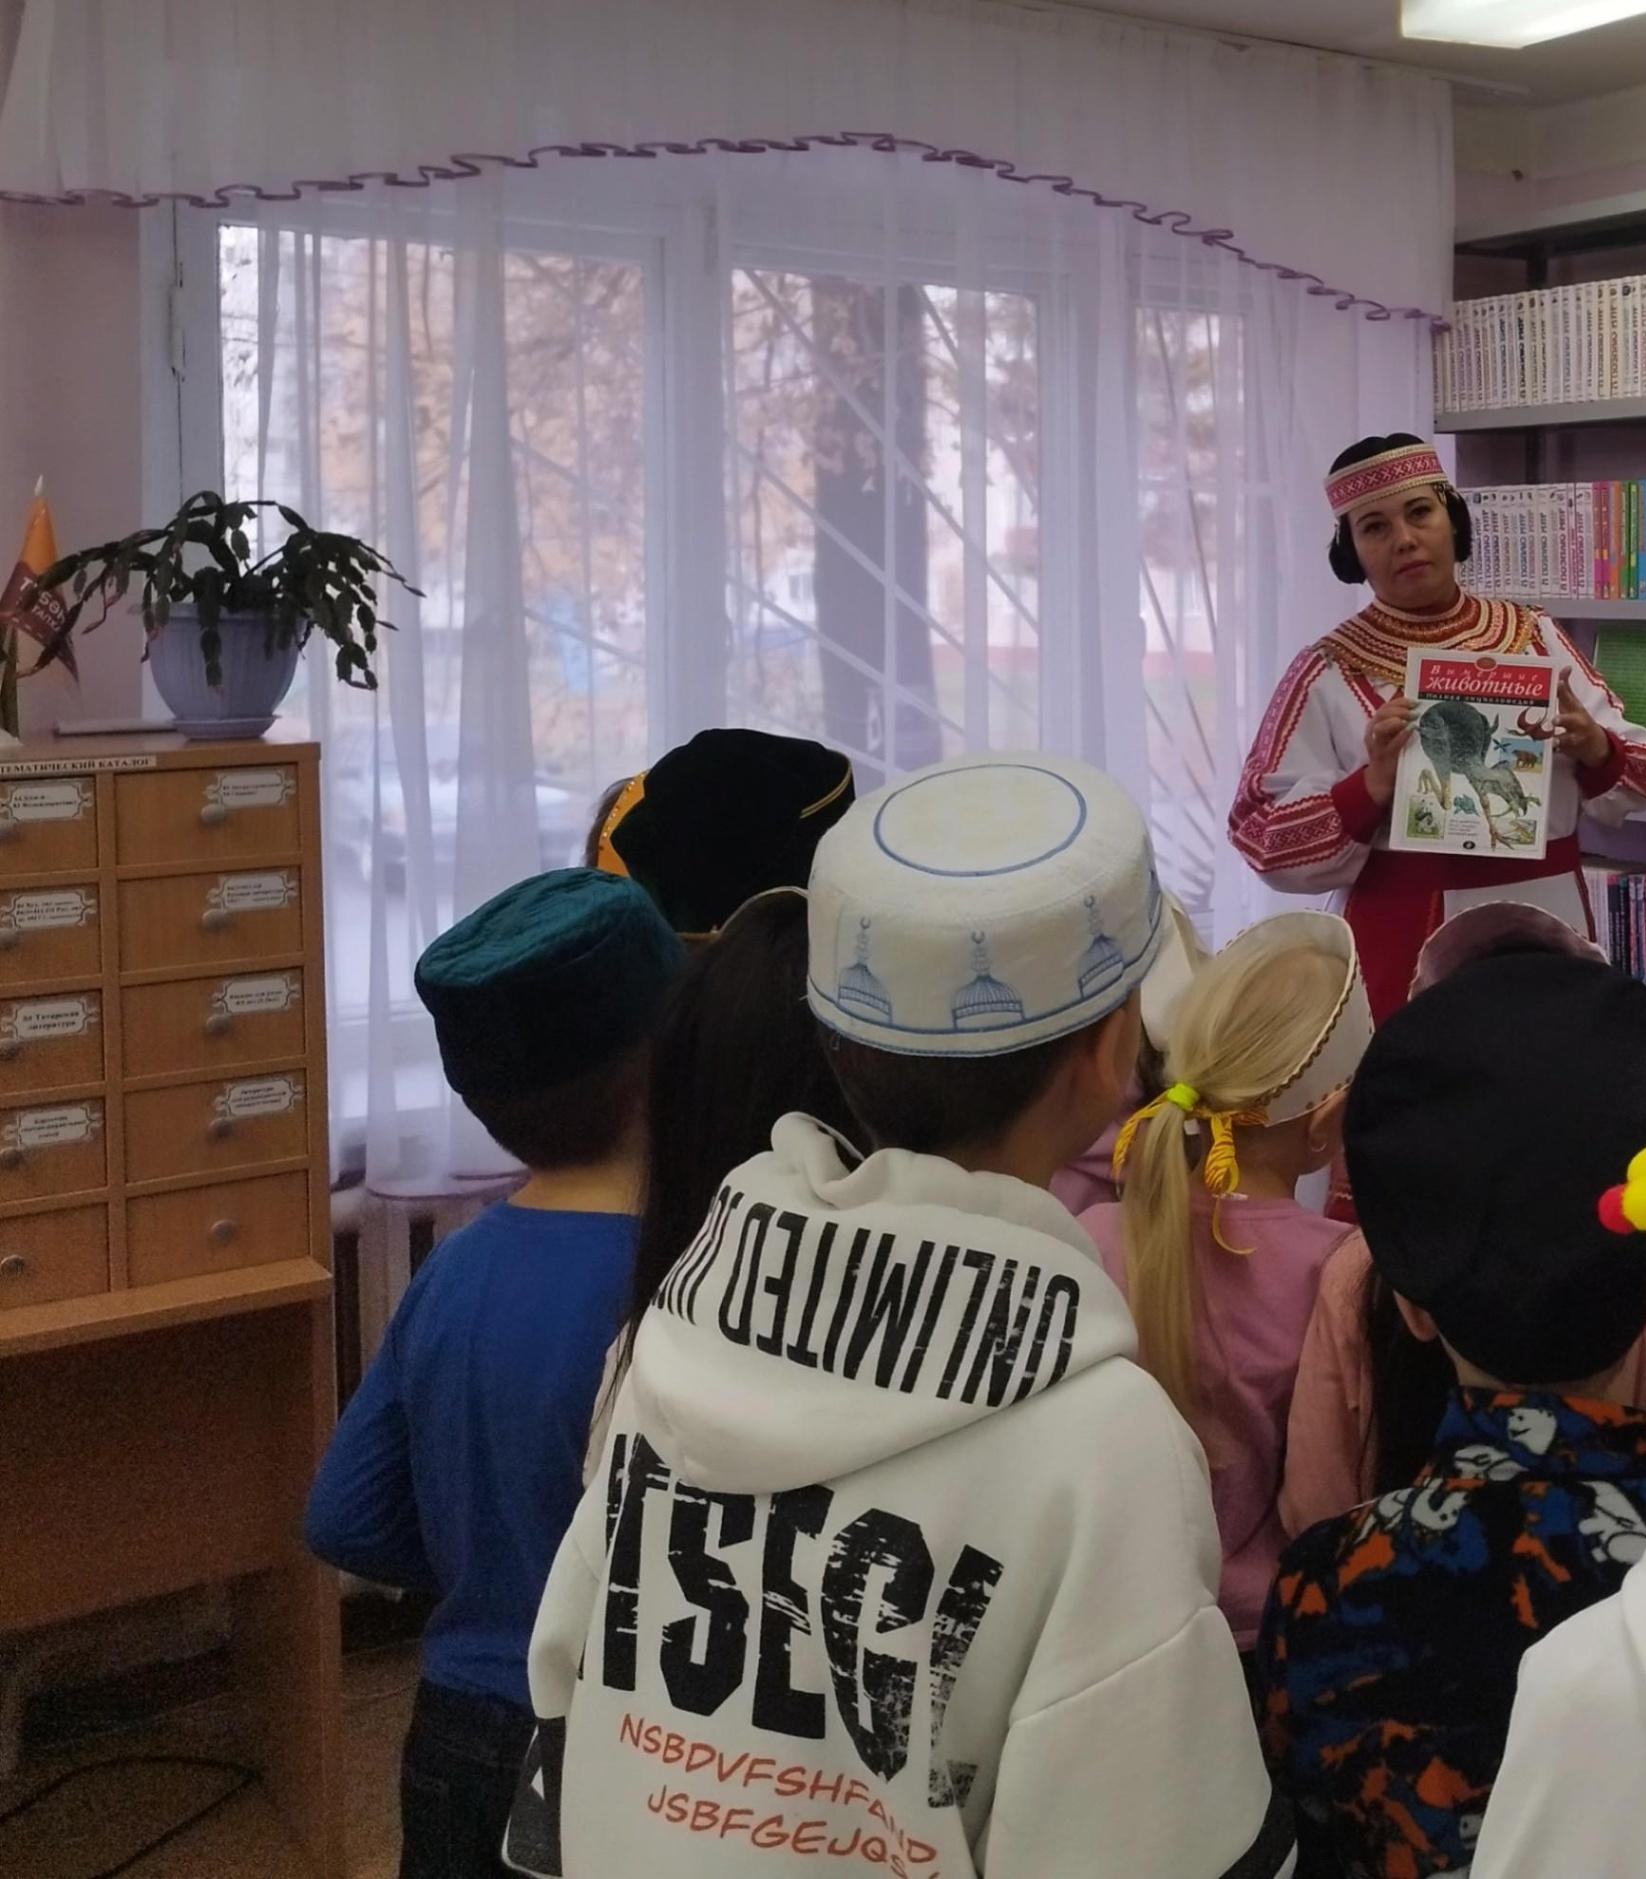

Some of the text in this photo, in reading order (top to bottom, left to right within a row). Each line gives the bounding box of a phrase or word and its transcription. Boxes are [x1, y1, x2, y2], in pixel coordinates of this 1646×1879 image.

[1426, 675, 1544, 697] животные
[99, 758, 149, 769] КАТАЛОГ
[718, 1201, 1081, 1408] UNLIMITED
